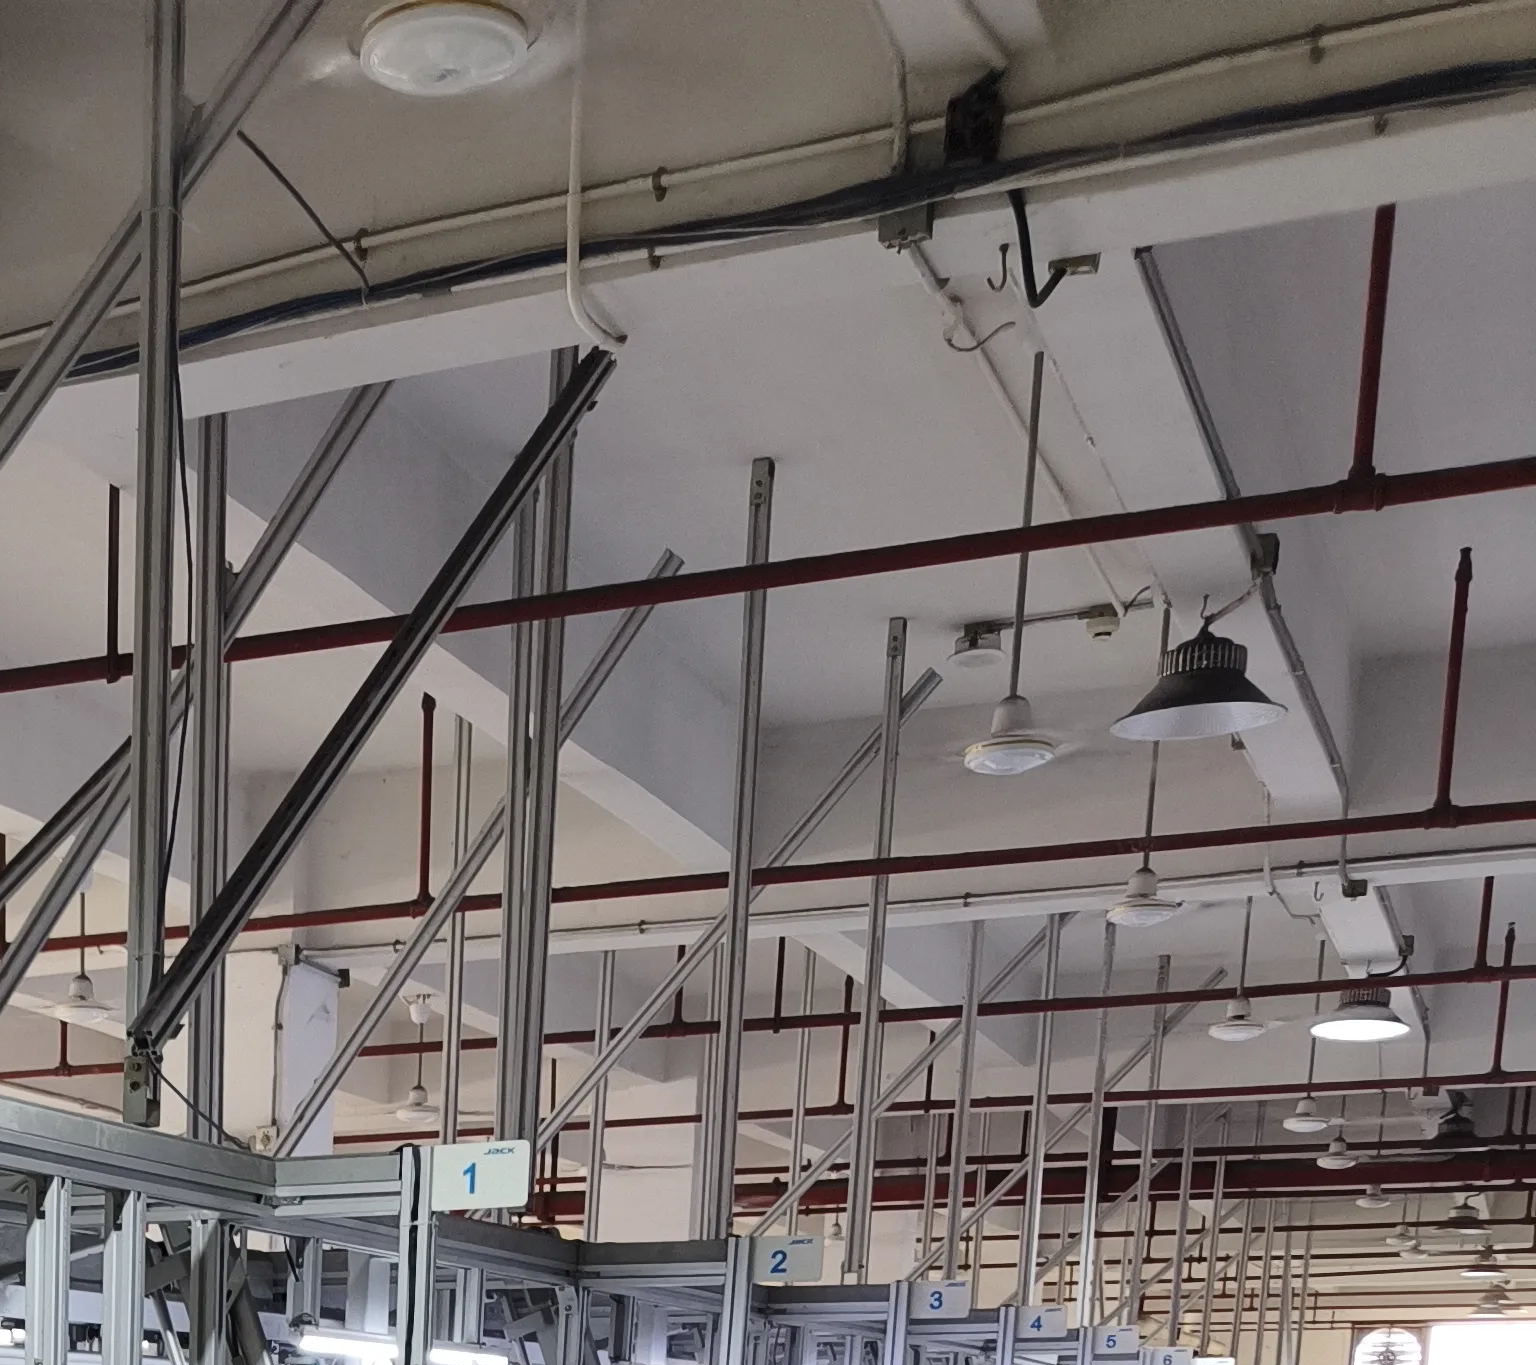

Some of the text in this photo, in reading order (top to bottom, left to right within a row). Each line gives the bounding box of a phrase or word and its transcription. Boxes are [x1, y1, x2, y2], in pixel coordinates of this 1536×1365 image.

[462, 1162, 477, 1195] 1
[770, 1249, 787, 1274] 2
[929, 1290, 943, 1310] 3
[1029, 1315, 1042, 1332] 4
[1105, 1334, 1117, 1349] 5
